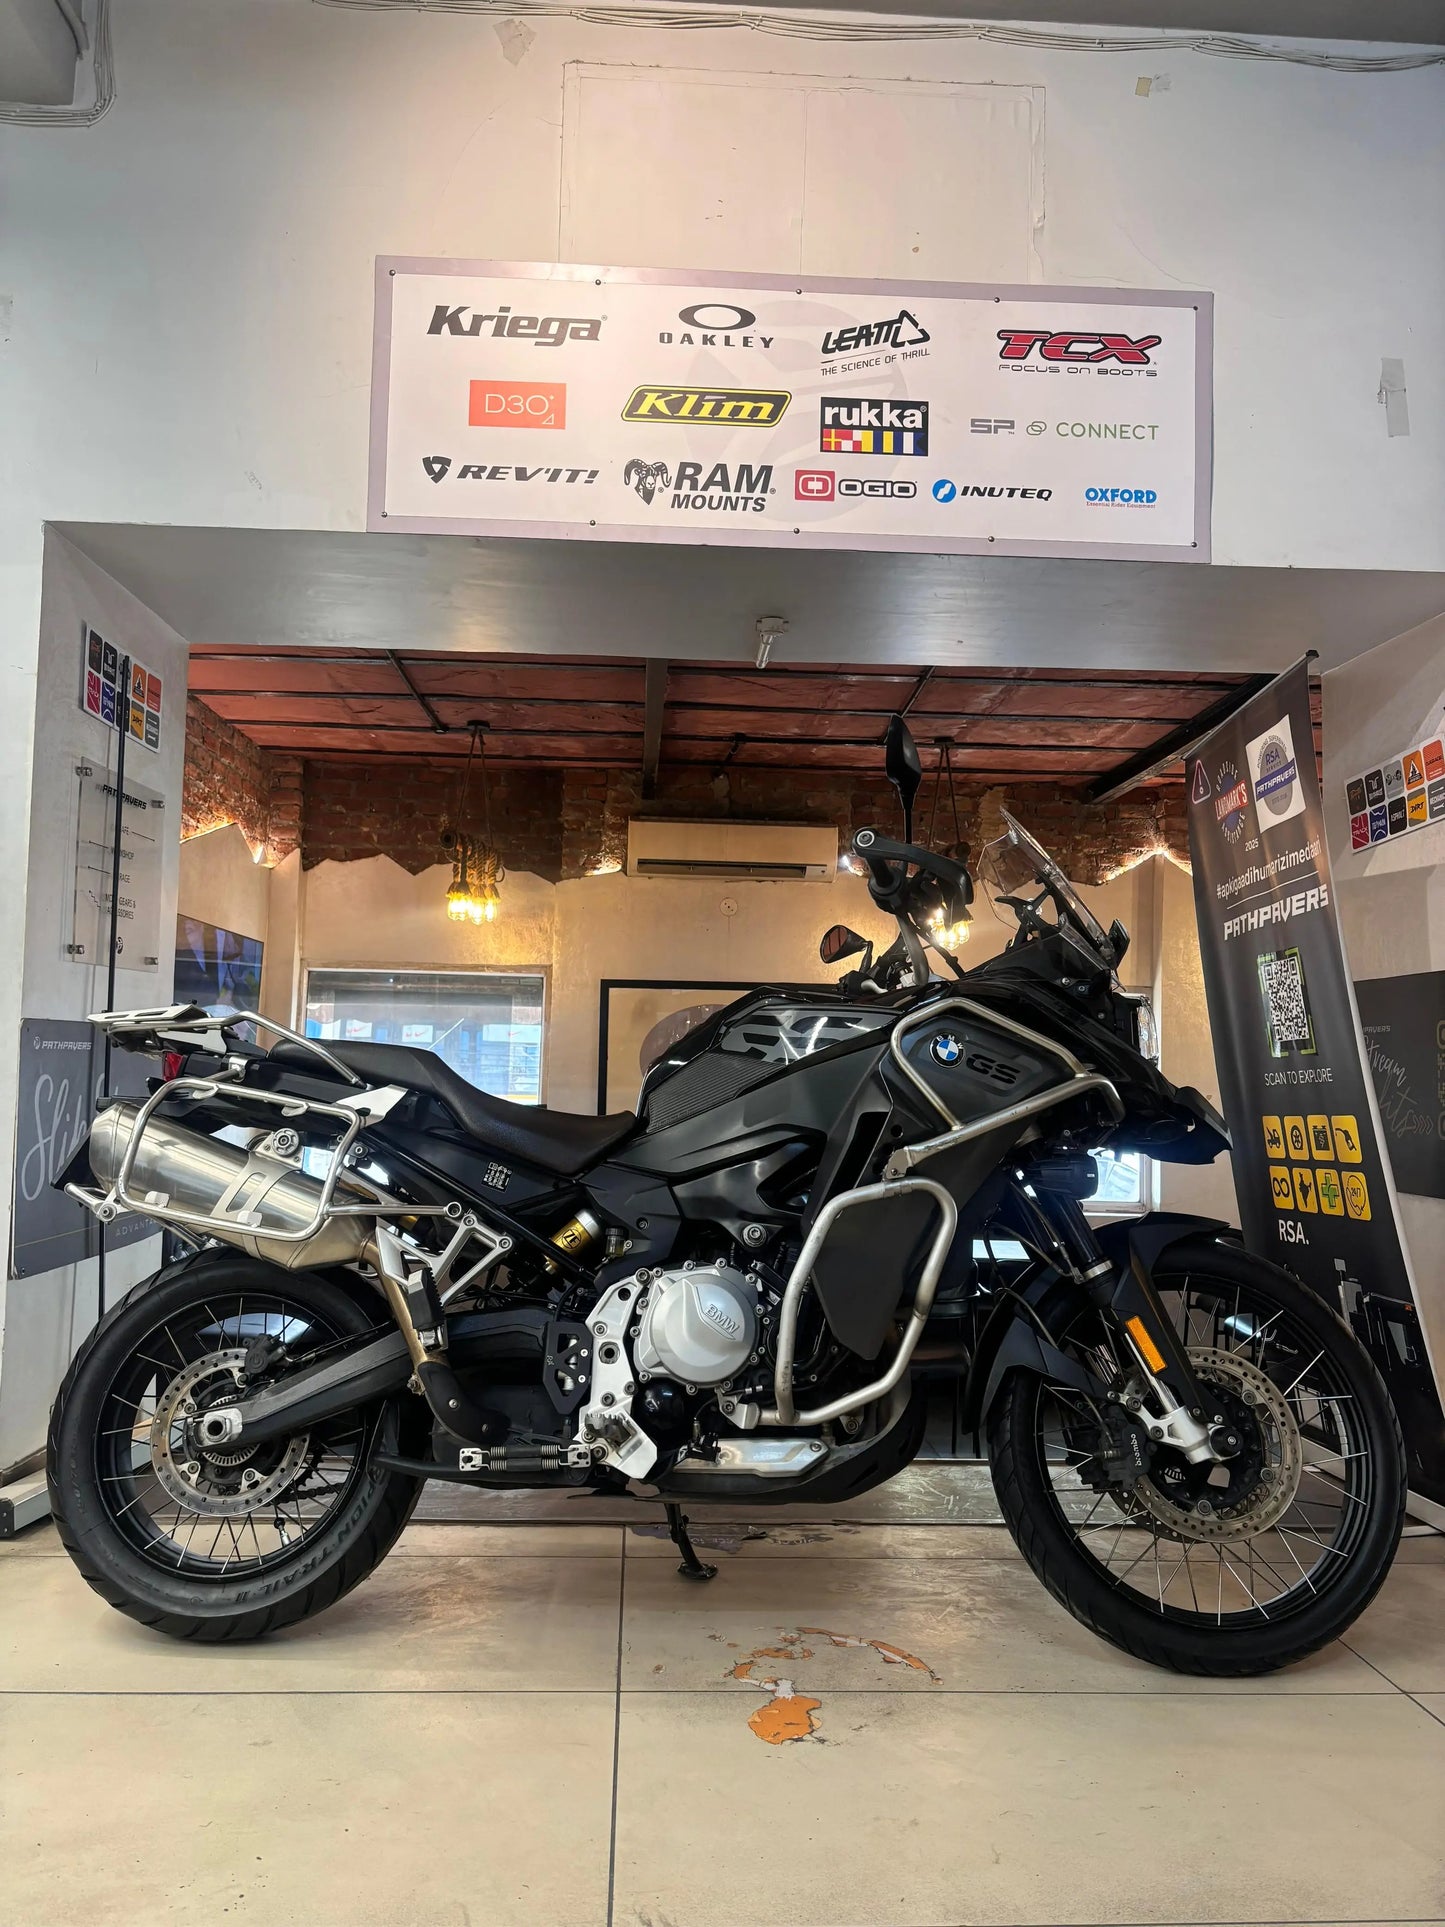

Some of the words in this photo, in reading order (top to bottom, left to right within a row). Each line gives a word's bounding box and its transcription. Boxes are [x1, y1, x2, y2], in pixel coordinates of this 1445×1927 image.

[427, 305, 602, 347] Kriega
[822, 312, 916, 354] LEATT
[659, 333, 774, 349] OAKLEY
[997, 329, 1162, 365] TCX
[821, 366, 837, 376] THE
[841, 358, 881, 373] SCIENCE
[885, 354, 897, 364] OF
[901, 348, 930, 361] THRILL
[999, 364, 1060, 374] FOCUS
[1097, 368, 1158, 377] BOOTS
[824, 402, 923, 429] rukka
[970, 418, 1015, 435] SP
[1056, 422, 1159, 441] CONNECT
[457, 464, 599, 484] REV'IT!
[674, 461, 773, 495] RAM
[838, 478, 917, 499] OGIO
[961, 485, 1053, 502] INUTEQ
[1085, 487, 1157, 503] OXFORD
[671, 493, 766, 512] MOUNTS
[1265, 748, 1280, 765] RSA
[1256, 766, 1296, 795] PATHPAVERS
[102, 784, 147, 810] PATPAVERS
[1411, 801, 1424, 814] DIRT
[1245, 838, 1259, 851] 2025
[1224, 884, 1329, 940] PATHPAVERS
[1363, 1025, 1391, 1034] PAVERS
[42, 1040, 92, 1051] PATHPAVERS
[966, 1053, 1021, 1085] GS
[1264, 1071, 1287, 1086] SCAN
[1287, 1071, 1298, 1084] TO
[1299, 1068, 1333, 1084] EXPLORE
[1278, 1219, 1309, 1245] RSA.
[704, 1303, 739, 1333] BMW
[1130, 1433, 1142, 1467] brembo
